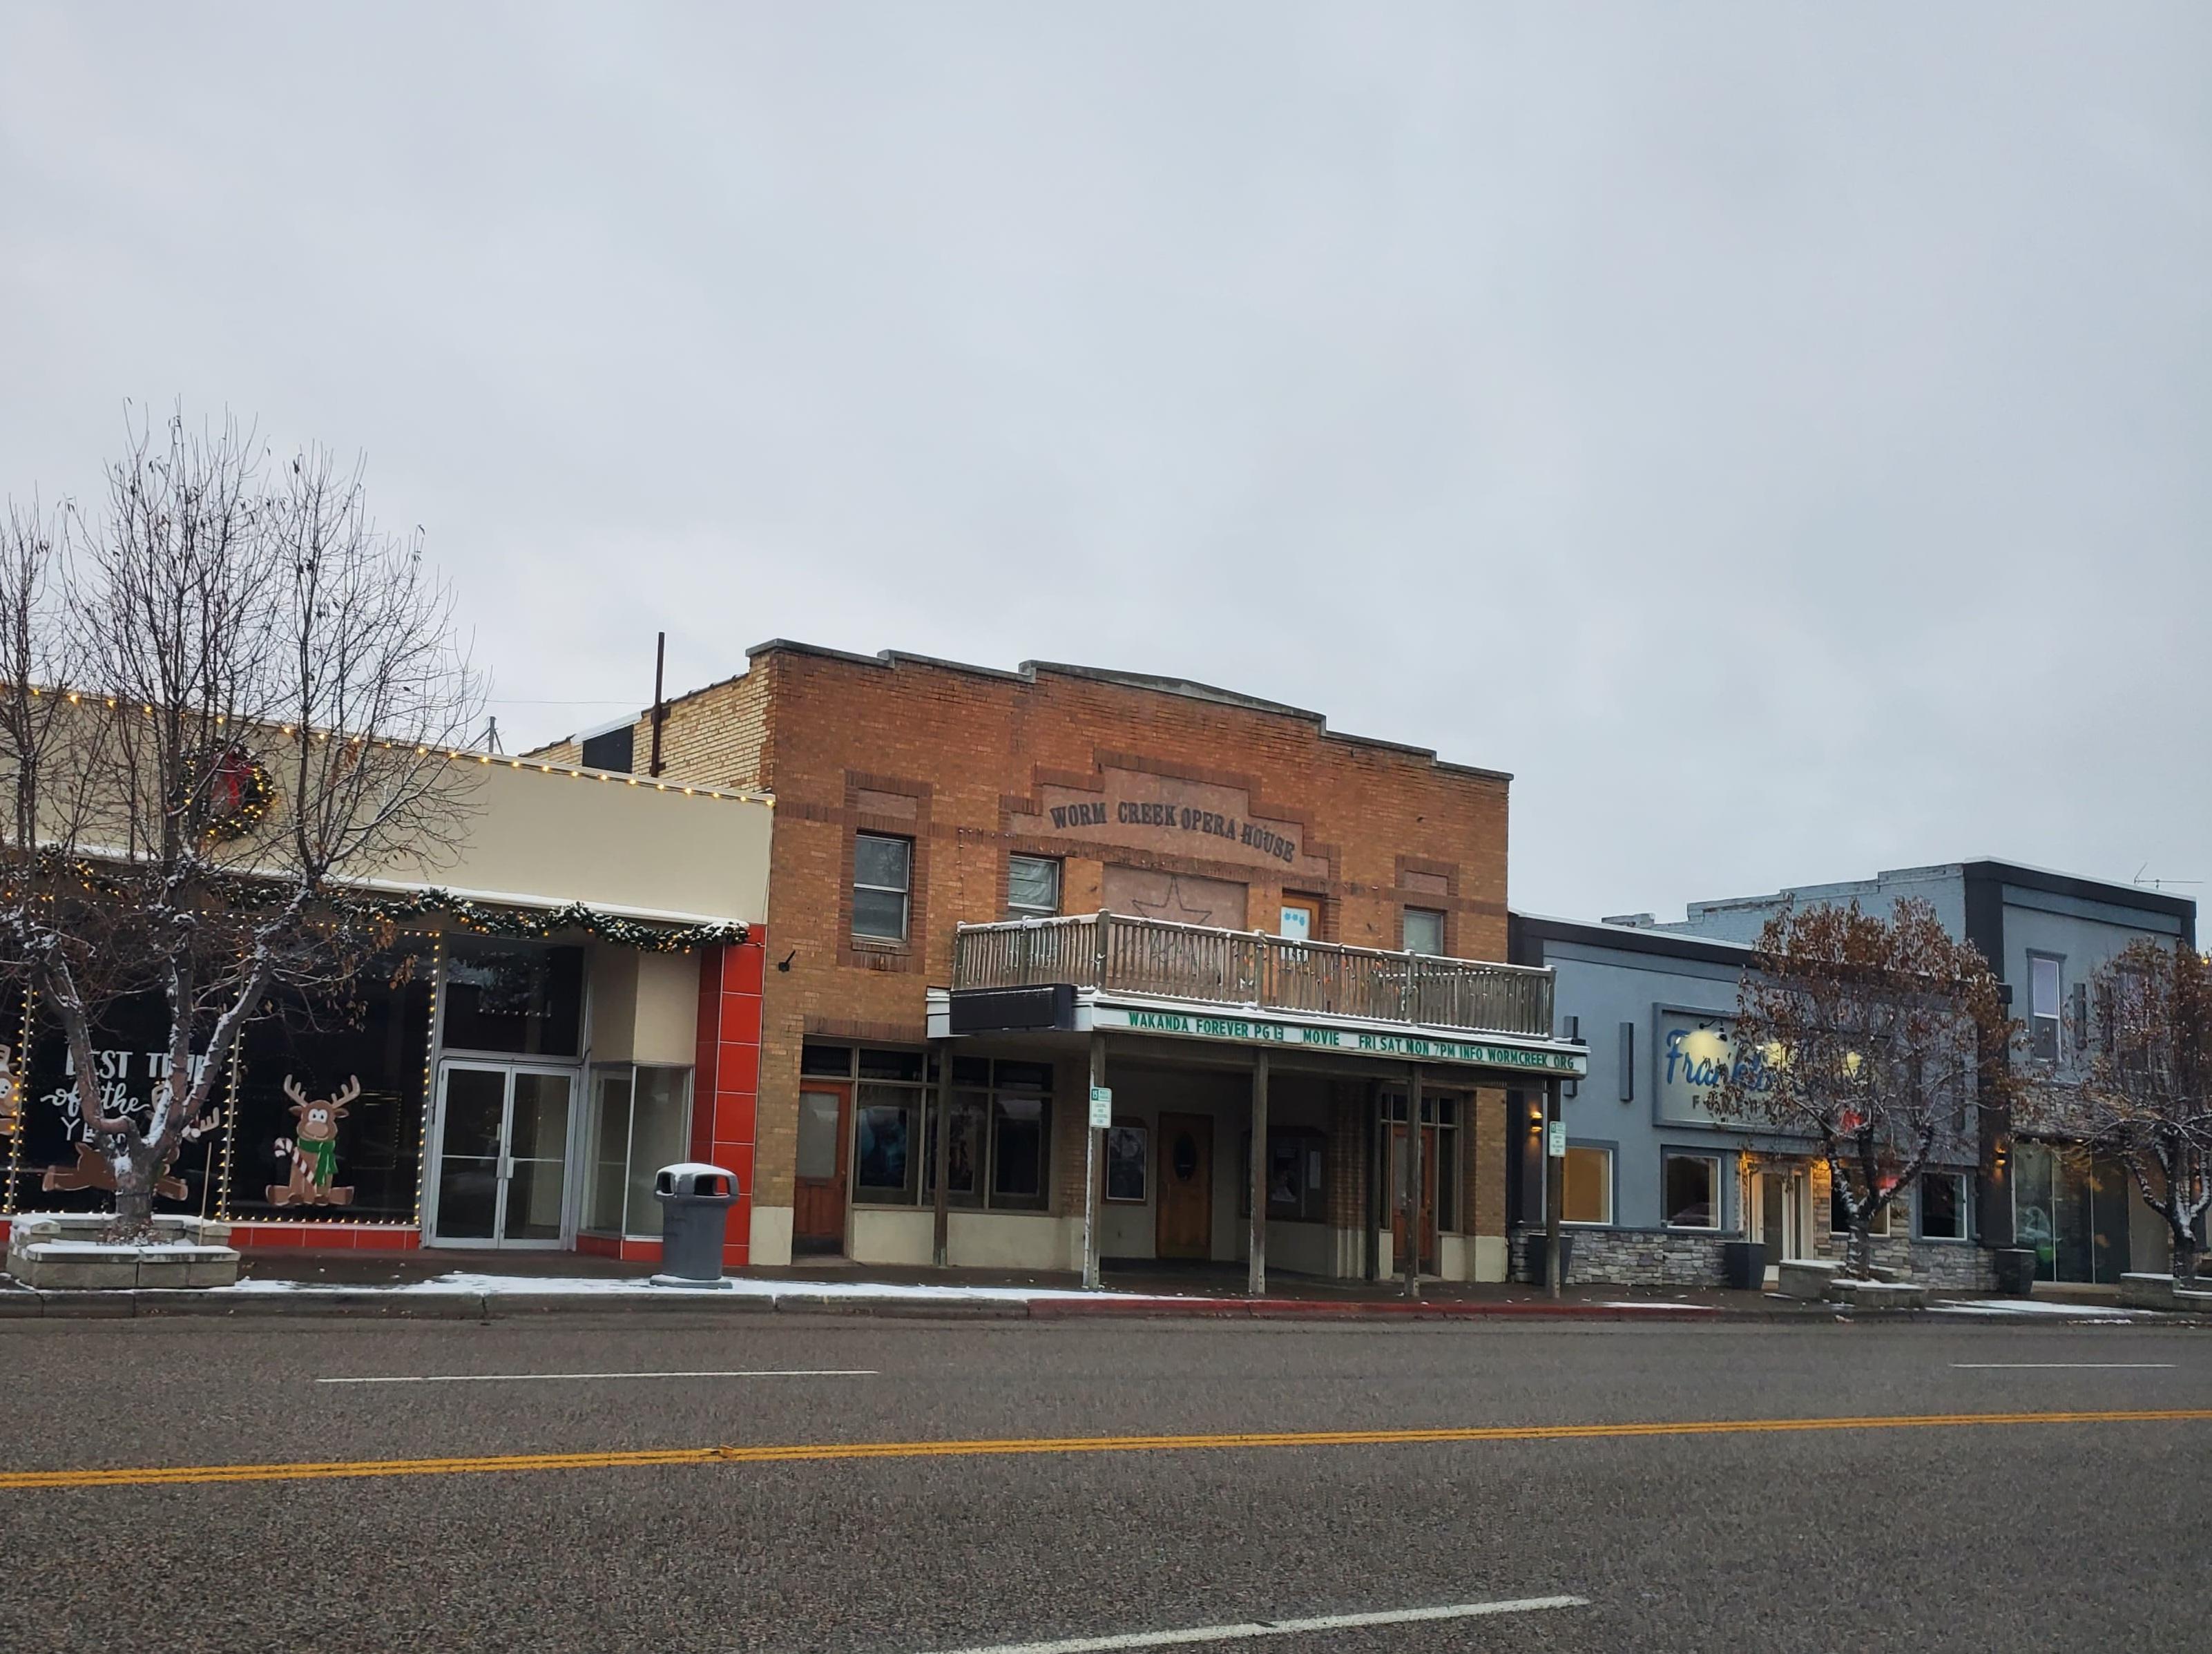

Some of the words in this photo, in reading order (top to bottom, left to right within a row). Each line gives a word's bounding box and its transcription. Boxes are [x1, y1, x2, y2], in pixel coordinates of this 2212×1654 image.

[1050, 802, 1107, 829] WORM
[1118, 801, 1177, 827] CREEK
[1181, 807, 1236, 840] OPERA
[1240, 823, 1295, 863] HOUSE
[1128, 1011, 1189, 1031] WAKANDA
[1196, 1018, 1248, 1037] FOREVER
[1254, 1024, 1269, 1039] PG
[1303, 1028, 1339, 1046] MOVIE
[1358, 1035, 1376, 1050] FRI
[1381, 1037, 1402, 1052] SAT
[1406, 1039, 1429, 1056] MON
[1459, 1046, 1483, 1061] INFO
[1487, 1048, 1548, 1068] WORMCREEK
[1554, 1056, 1574, 1069] ORG
[66, 1046, 133, 1079] ST
[146, 1052, 205, 1081] TI
[40, 1081, 82, 1117] of
[100, 1081, 151, 1114] the
[60, 1117, 127, 1143] YE
